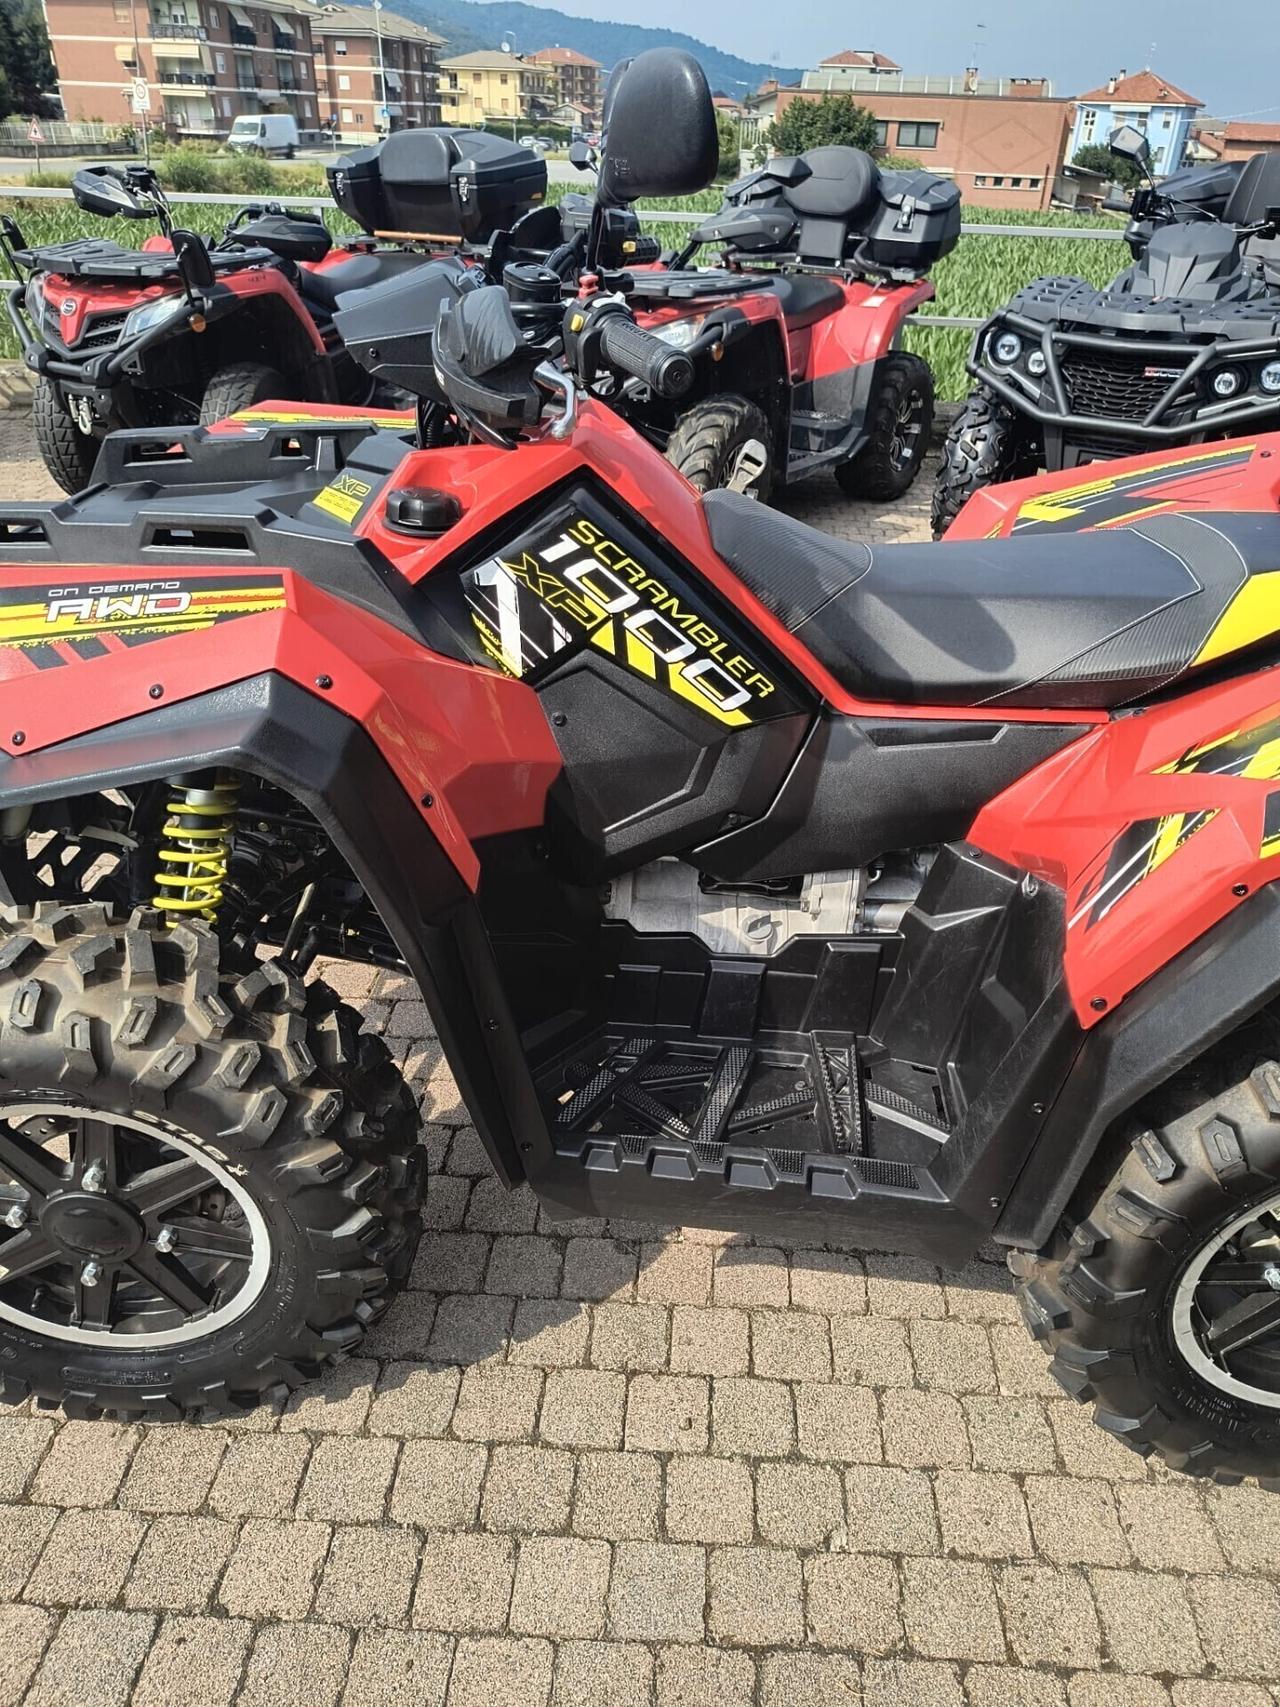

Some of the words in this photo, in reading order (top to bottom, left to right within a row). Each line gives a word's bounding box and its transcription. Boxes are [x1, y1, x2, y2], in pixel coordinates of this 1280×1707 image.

[332, 474, 372, 497] XP
[45, 592, 192, 622] AWD
[48, 587, 79, 598] ON
[88, 581, 180, 595] DEMAND
[503, 552, 601, 630] XP
[568, 520, 775, 698] SCRAMBLER
[539, 533, 752, 711] 1000
[132, 1109, 230, 1162] STAG
